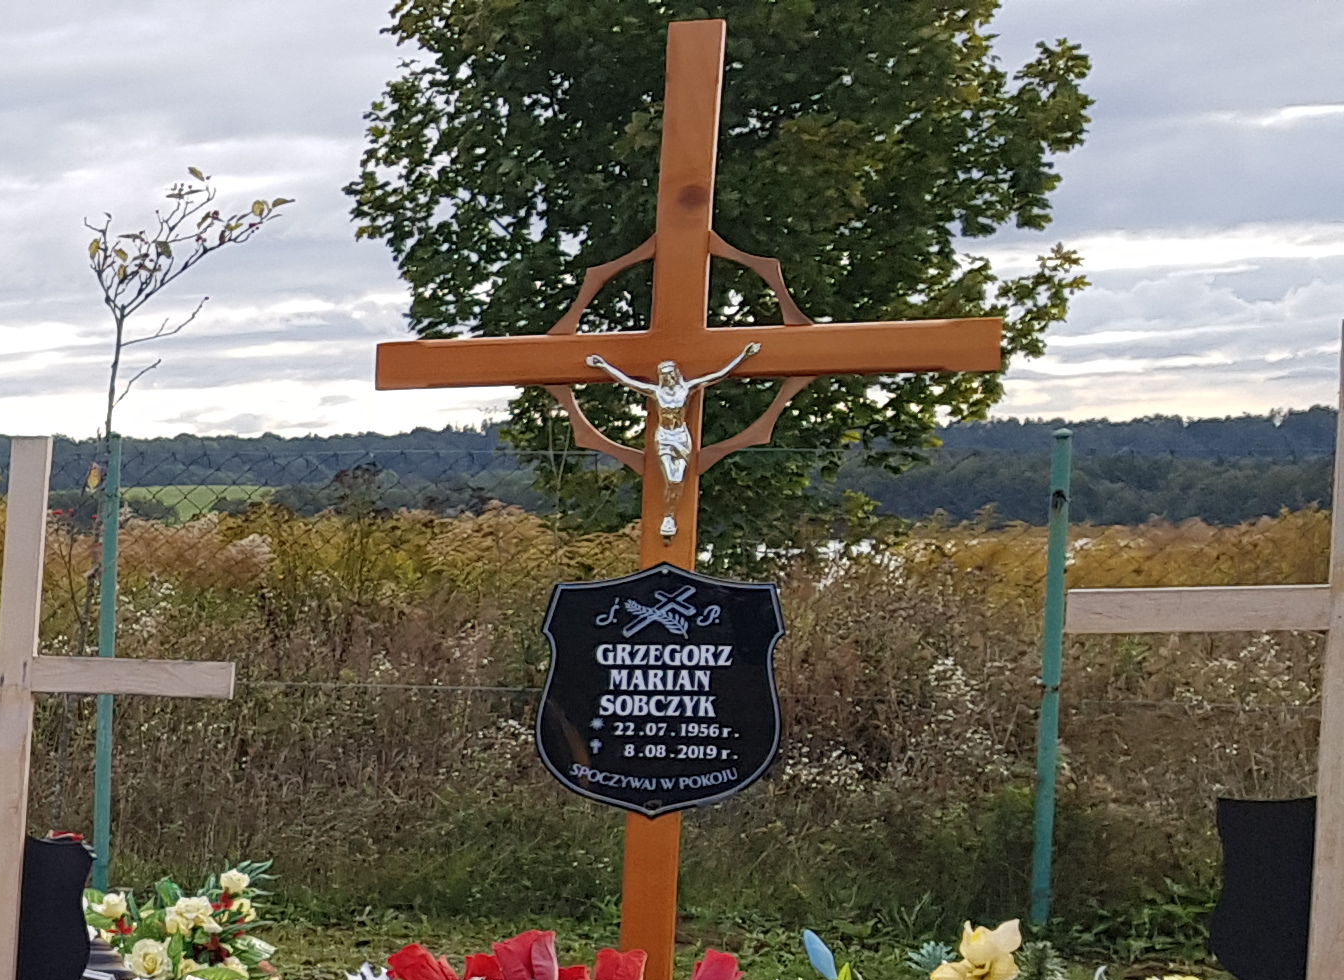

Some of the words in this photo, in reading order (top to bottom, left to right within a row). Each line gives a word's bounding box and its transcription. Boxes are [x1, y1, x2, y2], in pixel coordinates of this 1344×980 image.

[697, 604, 721, 626] P.
[596, 644, 733, 666] GRZEGORZ
[609, 669, 711, 691] MARIAN
[599, 695, 716, 717] SOBCZYK
[570, 763, 657, 791] SPOCZYWAJ
[662, 778, 675, 790] W
[679, 768, 739, 790] POKOJU
